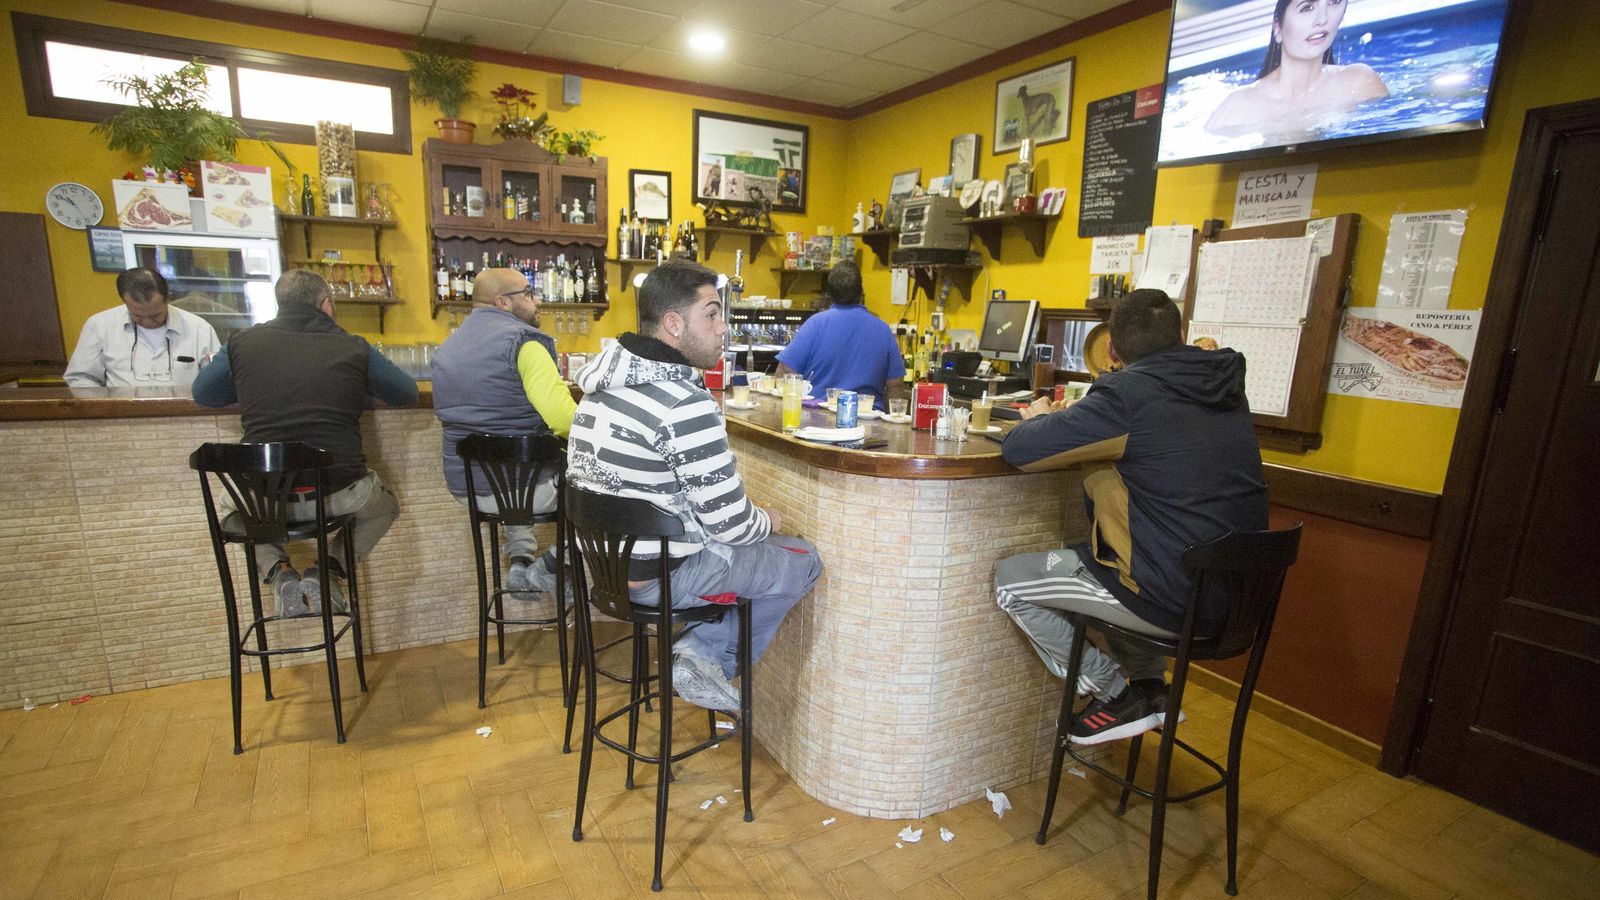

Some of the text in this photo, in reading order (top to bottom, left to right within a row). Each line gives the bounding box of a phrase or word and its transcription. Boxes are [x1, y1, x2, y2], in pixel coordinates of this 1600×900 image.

[1244, 172, 1305, 190] CESTA Y
[1238, 190, 1298, 205] MARISCADA
[1100, 250, 1129, 258] TARJETA
[1336, 367, 1345, 375] EL
